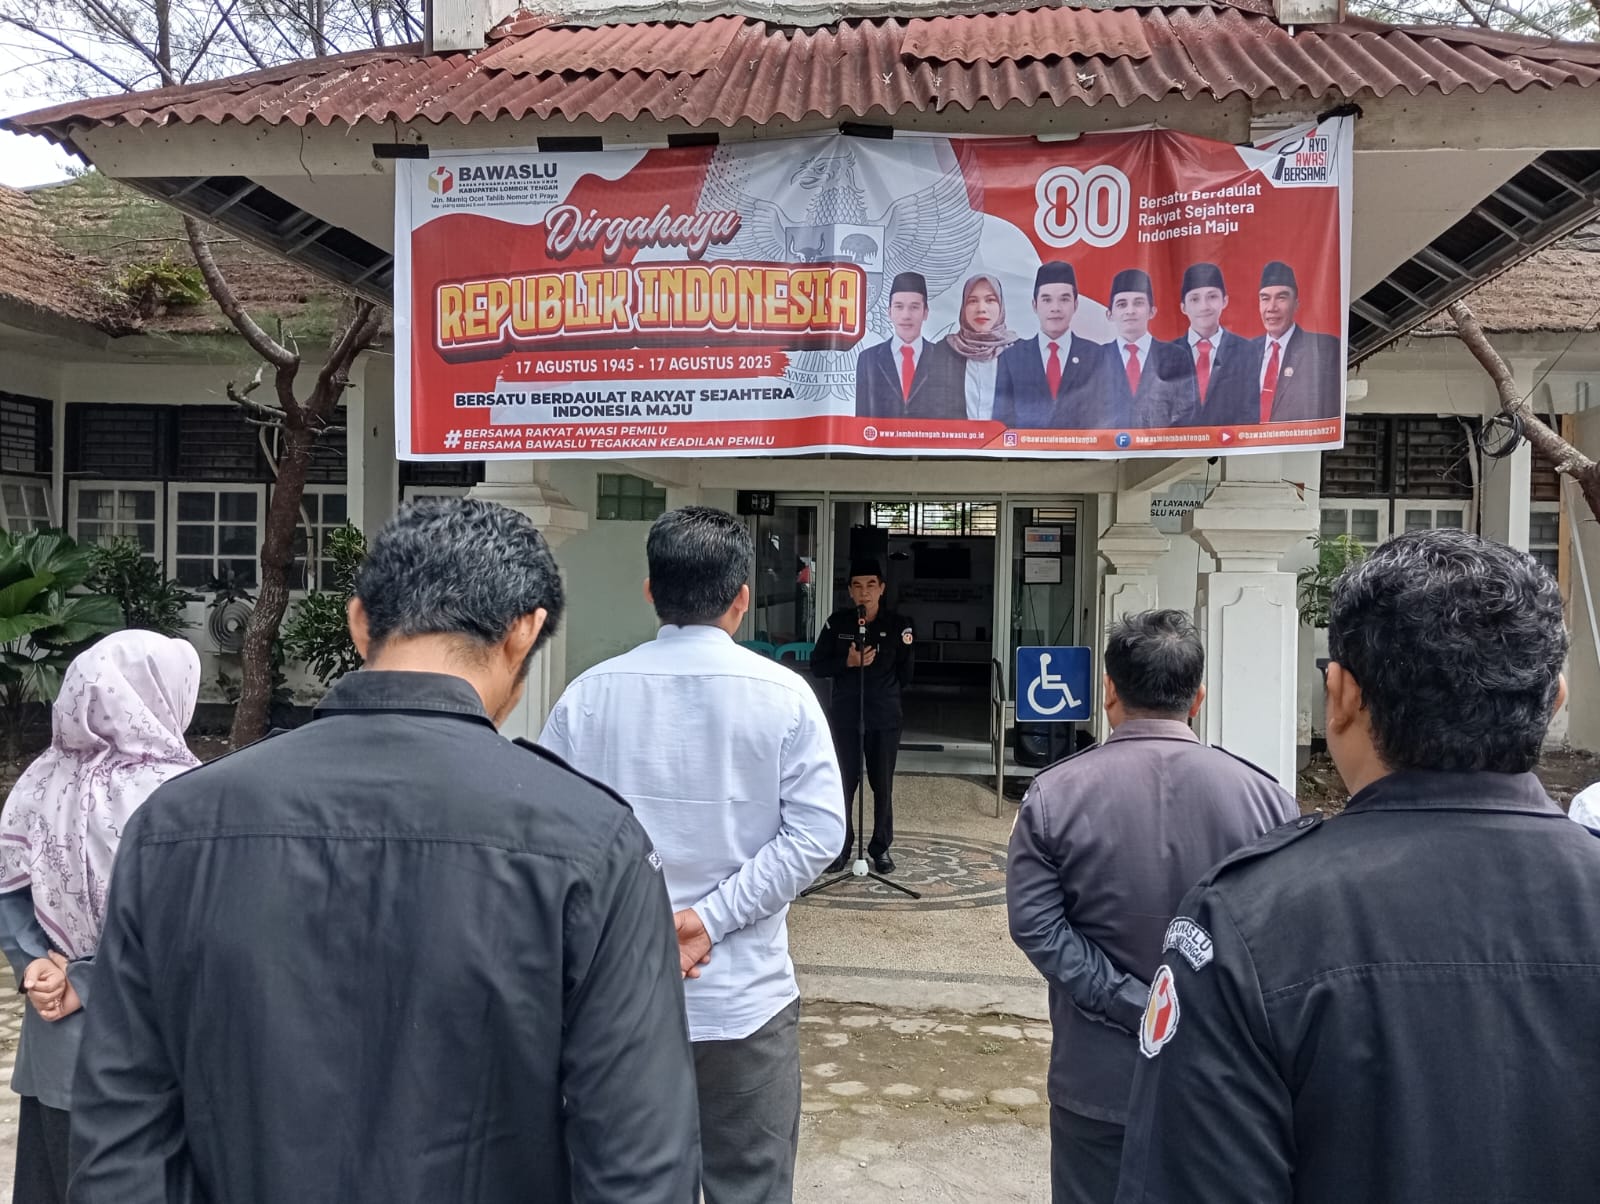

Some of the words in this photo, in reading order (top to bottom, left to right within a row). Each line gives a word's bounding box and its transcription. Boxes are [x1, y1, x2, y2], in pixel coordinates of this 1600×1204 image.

[1308, 138, 1327, 152] AYO
[1295, 152, 1327, 167] AWASI
[458, 163, 558, 181] BAWASLU
[1283, 167, 1327, 181] BERSAMA
[539, 193, 558, 201] Praya
[1139, 191, 1188, 209] Bersatu
[1191, 183, 1262, 201] Berdaulat
[1034, 164, 1131, 248] 80
[1138, 208, 1181, 226] Rakyat
[1184, 202, 1255, 220] Sejahtera
[545, 204, 740, 258] Dirgahayu
[1138, 222, 1201, 243] Indonesia
[1205, 219, 1239, 236] Maju
[439, 269, 630, 344] REPUBLIK
[638, 265, 858, 334] INDONESIA
[516, 360, 531, 374] 17
[535, 359, 598, 373] AGUSTUS
[602, 358, 635, 372] 1945
[649, 358, 665, 371] 17
[668, 356, 735, 370] AGUSTUS
[738, 355, 772, 369] 2025
[455, 393, 526, 407] BERSATU
[530, 391, 627, 405] BERDAULAT
[631, 390, 696, 403] RAKYAT
[699, 387, 795, 401] SEJAHTERA
[553, 404, 642, 418] INDONESIA
[646, 403, 693, 416] MAJU
[463, 428, 522, 438] BERSAMA
[525, 427, 576, 437] RAKYAT
[575, 426, 617, 436] AWASI
[620, 426, 668, 436] PEMILU
[463, 440, 522, 450] BERSAMA
[525, 439, 587, 449] BAWASLU
[590, 437, 659, 448] TEGAKKAN
[660, 437, 725, 447] KEADILAN
[727, 436, 775, 446] PEMILU
[1163, 499, 1201, 507] LAYANAN
[1150, 509, 1167, 517] SLU
